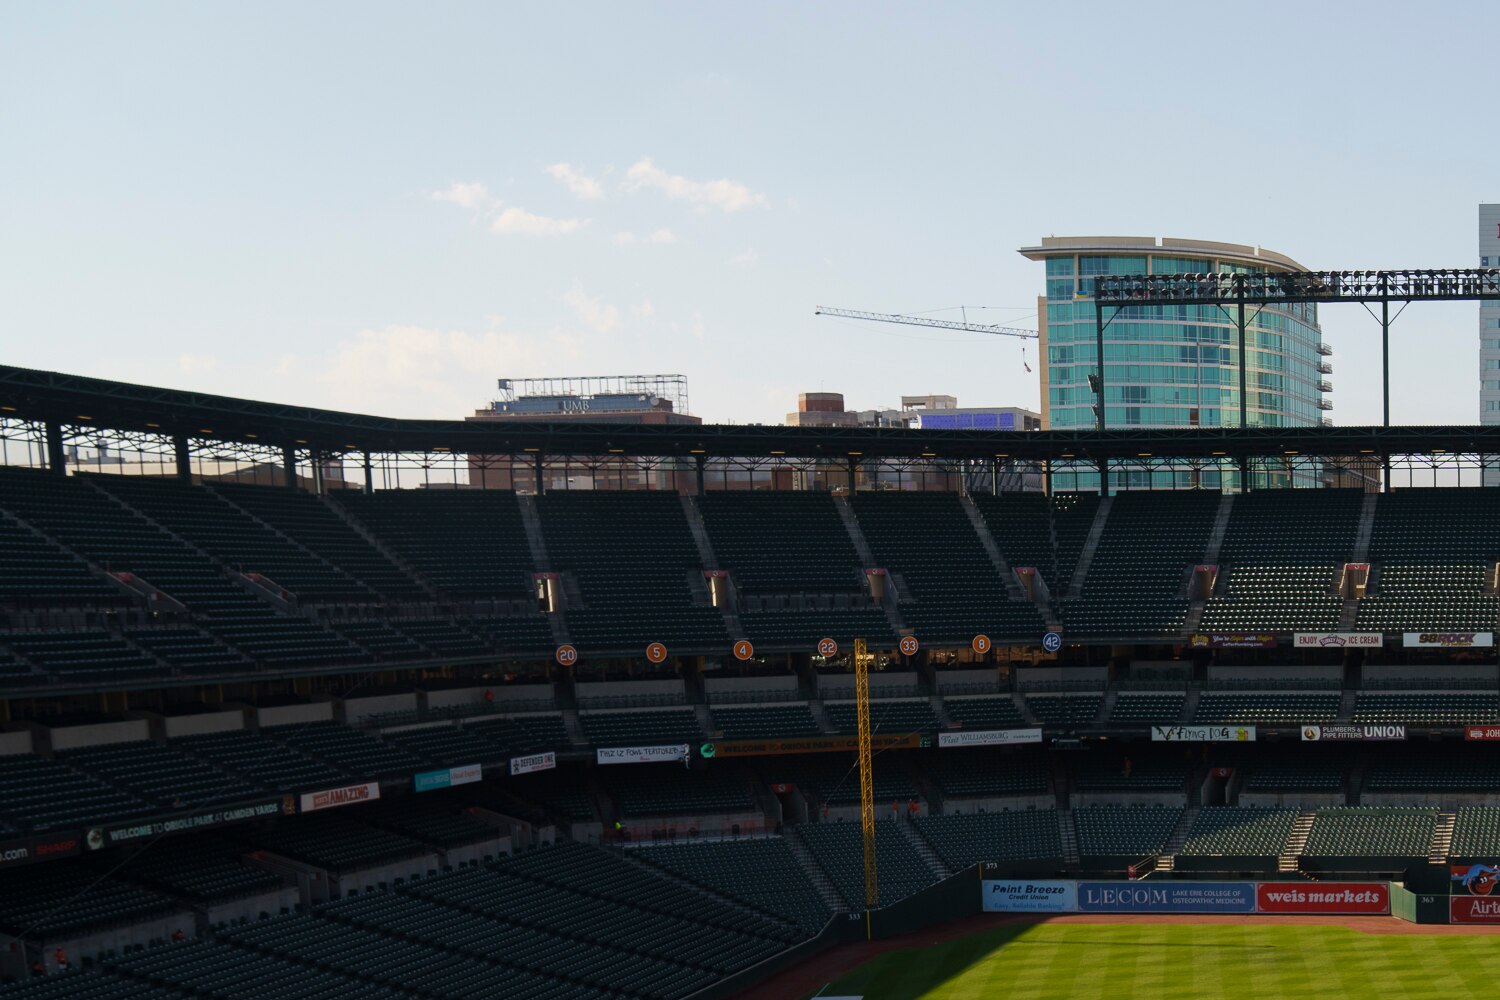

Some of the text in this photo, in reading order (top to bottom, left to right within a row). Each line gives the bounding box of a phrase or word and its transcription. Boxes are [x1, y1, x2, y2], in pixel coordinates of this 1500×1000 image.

[563, 400, 590, 411] UMB
[903, 640, 916, 651] 33
[978, 638, 985, 650] 8
[1045, 636, 1059, 648] 42
[1299, 636, 1379, 645] ENJOY ICE CREAM
[653, 646, 661, 658] 5
[739, 644, 747, 656] 4
[821, 642, 835, 653] 22
[559, 649, 575, 661] 20
[1364, 726, 1405, 737] UNION
[330, 785, 369, 804] AMAZING
[111, 824, 152, 841] WELCOME
[152, 822, 163, 833] TO
[164, 819, 194, 832] ORIOLE
[194, 814, 214, 826] PARK
[223, 808, 256, 821] CAMDEN
[255, 803, 278, 816] YARDS
[986, 862, 998, 870] 373
[1025, 885, 1064, 894] Breeze
[1214, 897, 1246, 905] MEDICINE
[1267, 890, 1380, 904] weis markets
